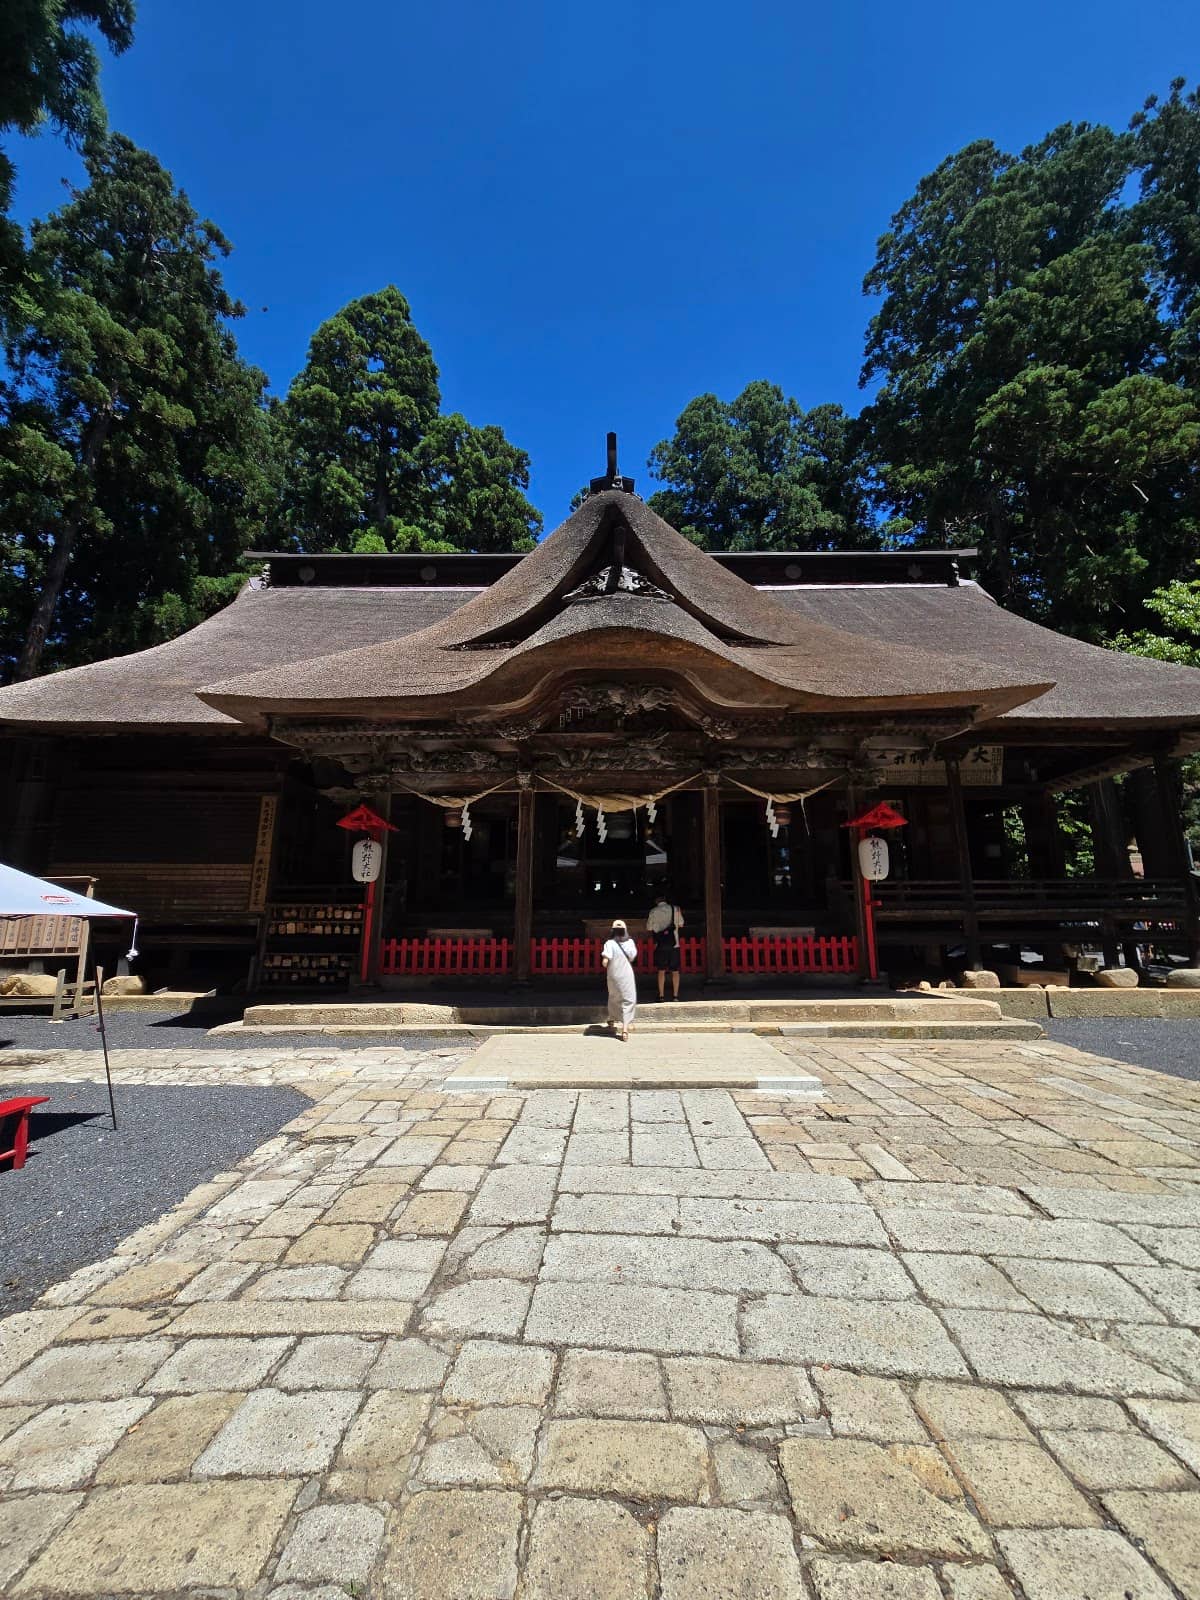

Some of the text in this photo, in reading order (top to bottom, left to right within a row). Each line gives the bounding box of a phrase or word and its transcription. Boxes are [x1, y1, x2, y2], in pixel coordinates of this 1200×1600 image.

[361, 841, 374, 879] 熊野大社
[870, 839, 882, 875] 熊野大社
